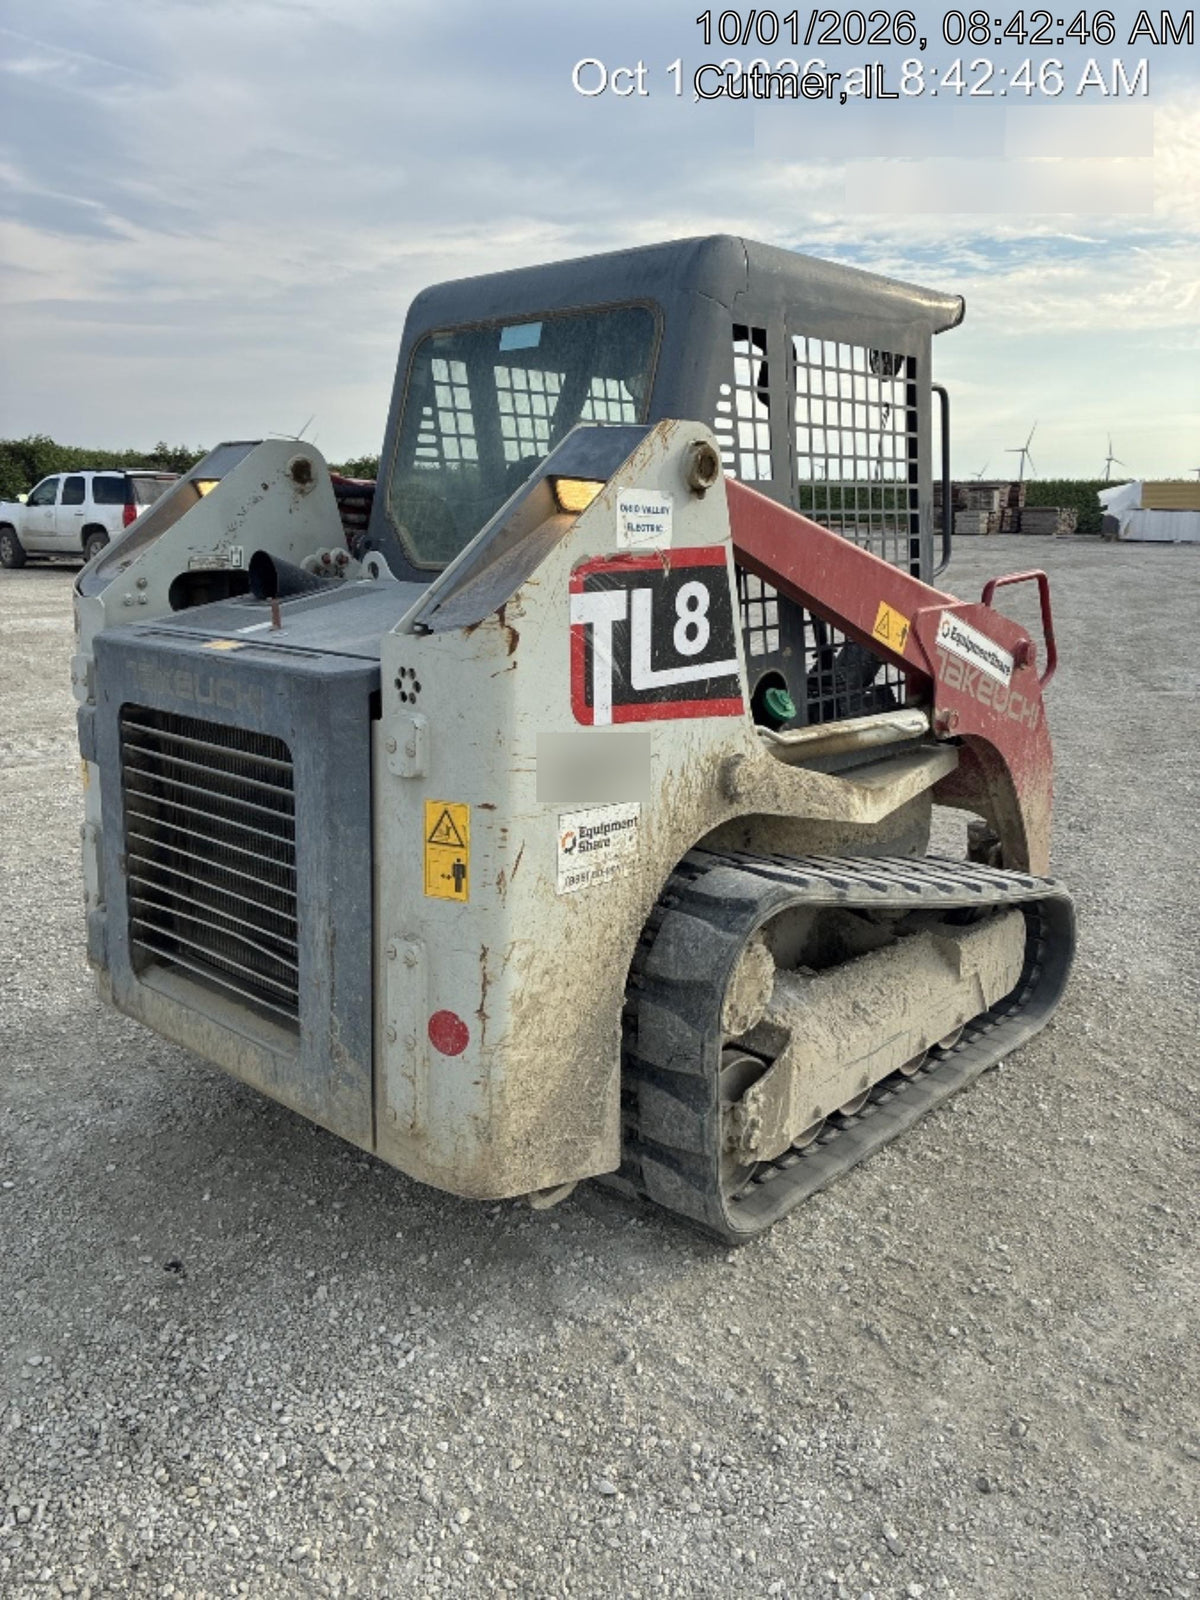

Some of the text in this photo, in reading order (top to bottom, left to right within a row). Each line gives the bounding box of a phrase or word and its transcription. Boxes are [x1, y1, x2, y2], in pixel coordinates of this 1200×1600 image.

[569, 580, 741, 726] TL8
[578, 815, 638, 840] Equipment
[578, 838, 611, 854] Share
